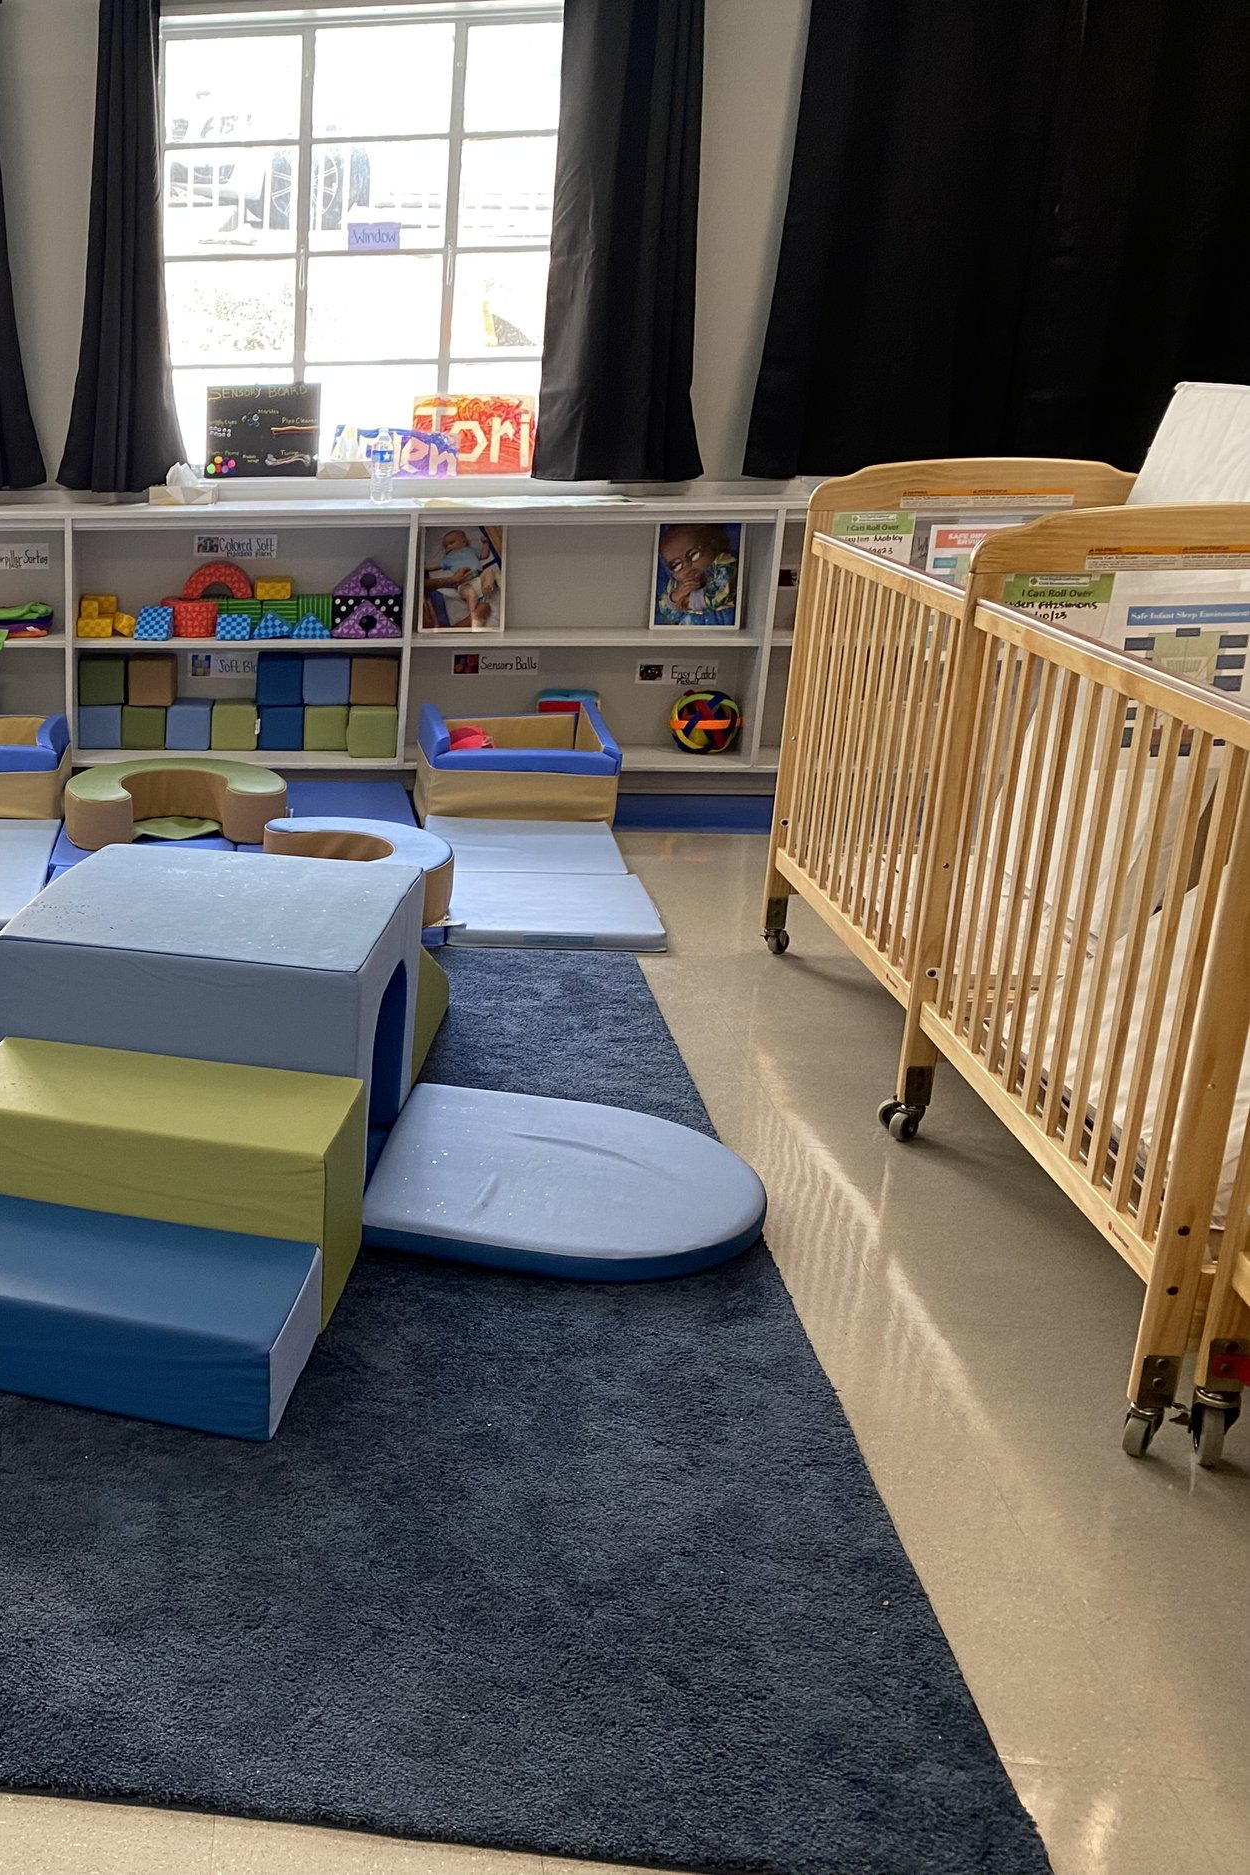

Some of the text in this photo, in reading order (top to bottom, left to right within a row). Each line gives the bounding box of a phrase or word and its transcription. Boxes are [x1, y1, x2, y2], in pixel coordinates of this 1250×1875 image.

[352, 228, 396, 244] Window
[208, 385, 308, 400] SENSORY BOARD
[414, 406, 532, 468] Tori
[257, 538, 275, 552] Soft
[1048, 589, 1066, 597] Roll
[1069, 589, 1093, 597] Over
[1150, 612, 1174, 620] Infant
[1176, 611, 1197, 620] Sleep
[1199, 610, 1250, 618] Environment
[219, 659, 241, 673] Soft
[480, 656, 537, 670] Sensory Balls
